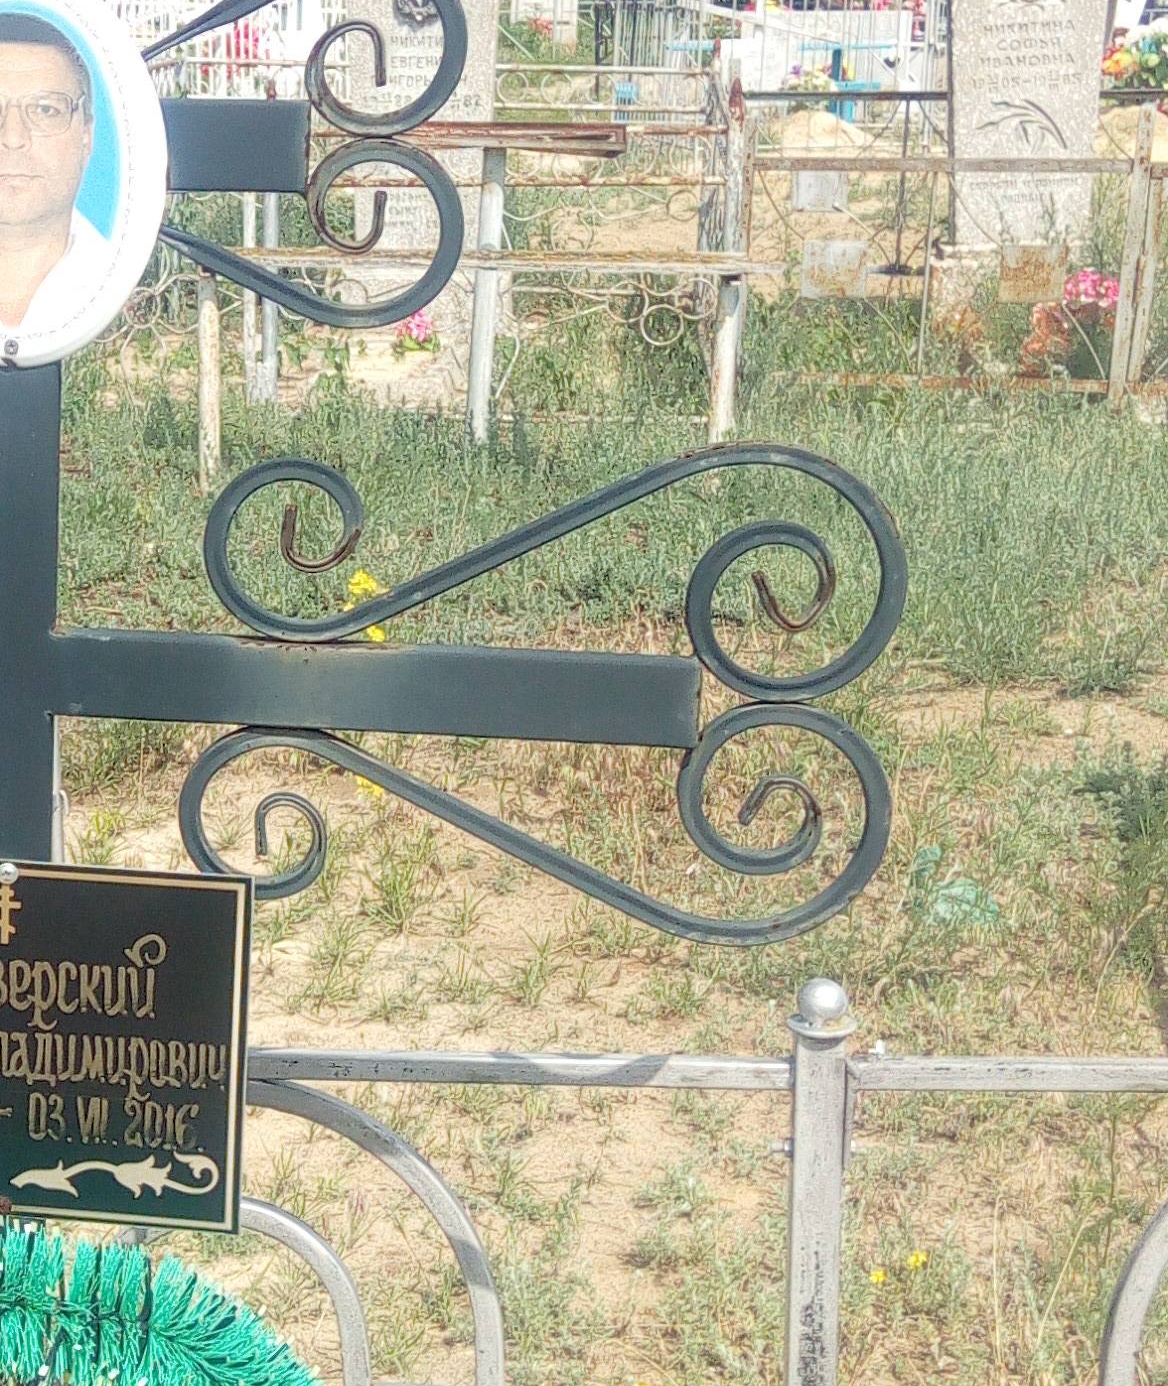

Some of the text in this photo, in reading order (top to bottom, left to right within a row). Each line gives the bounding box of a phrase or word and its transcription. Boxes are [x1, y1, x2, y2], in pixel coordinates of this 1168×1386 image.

[983, 20, 1076, 37] НИКИТИНА
[390, 35, 444, 48] НИКИТИ
[996, 37, 1062, 52] СОФЬЯ
[390, 55, 442, 69] ЕВГЕНИ
[980, 53, 1076, 68] ИВАНОВНА
